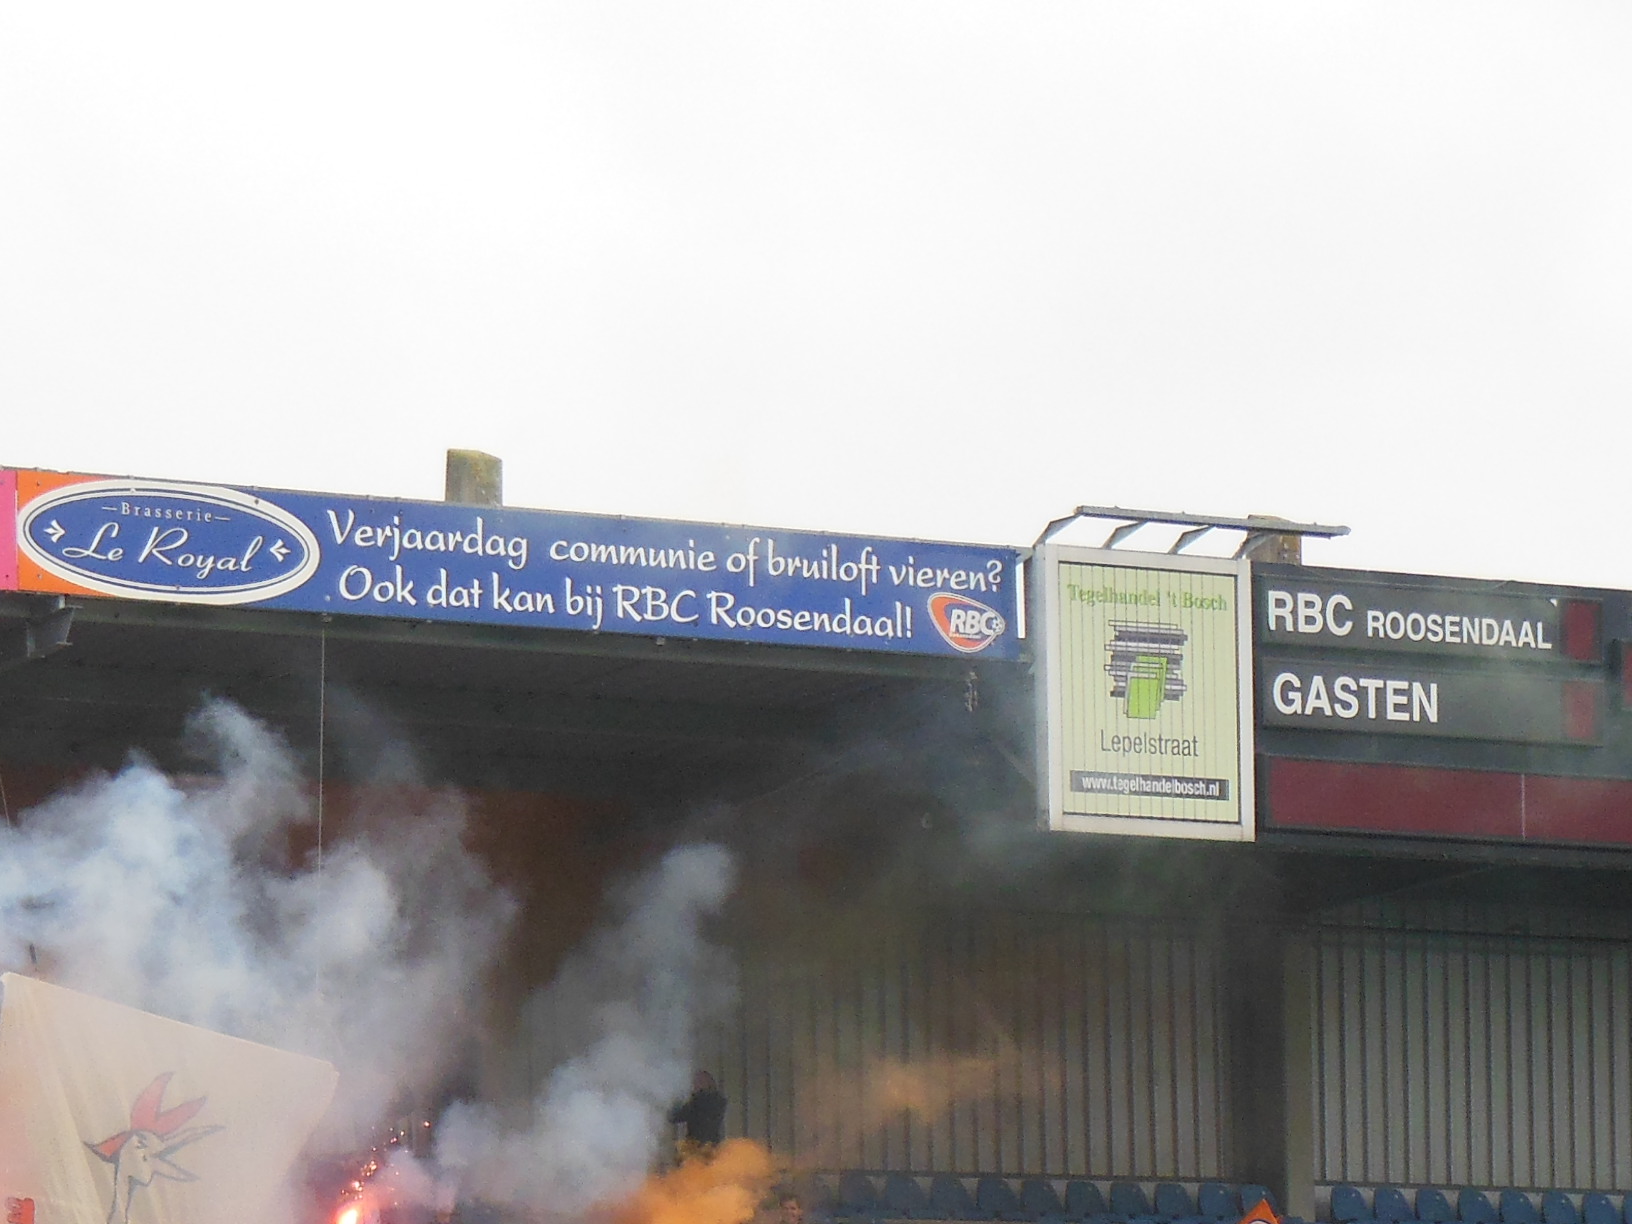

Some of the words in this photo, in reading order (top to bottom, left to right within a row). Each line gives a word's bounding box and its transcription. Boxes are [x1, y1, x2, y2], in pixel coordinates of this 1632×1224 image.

[120, 502, 212, 523] Brasserie
[62, 522, 124, 561] Le
[137, 526, 263, 579] Royal
[327, 509, 528, 569] Verjaardag
[549, 539, 717, 572] communie
[726, 537, 761, 587] of
[768, 540, 881, 596] bruiloft
[888, 556, 1003, 591] vieren?
[338, 564, 417, 606] Ook
[426, 568, 483, 608] dat
[492, 571, 555, 614] kan
[565, 577, 603, 630] bij
[612, 583, 699, 622] RBC
[706, 591, 913, 638] Roosendaal!
[1067, 583, 1160, 607] Tegelhandel
[1182, 591, 1227, 611] Bosch
[950, 608, 997, 636] RBC
[1268, 590, 1354, 636] RBC
[1366, 609, 1553, 650] ROOSENDAAL
[1273, 672, 1438, 723] GASTEN
[1100, 729, 1199, 757] Lepelstraat
[1081, 775, 1220, 797] www.tegelhandelbosch.nl
